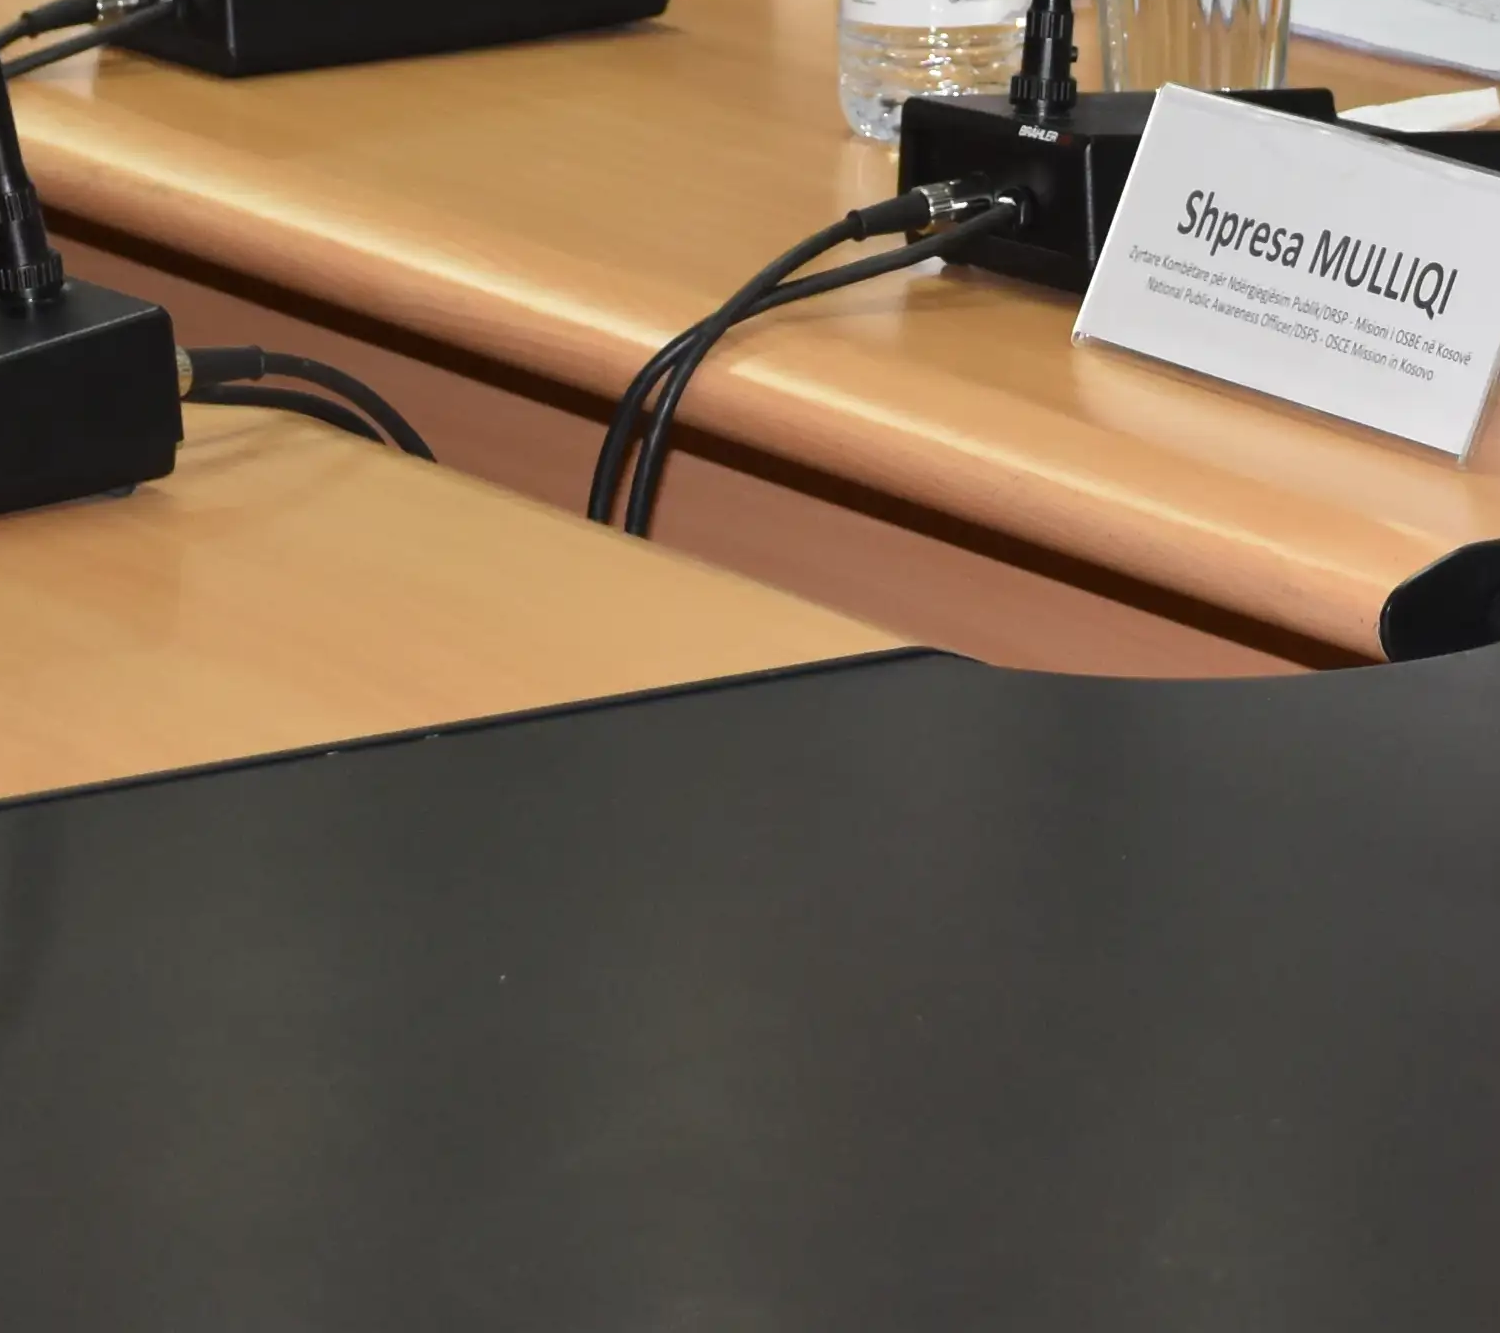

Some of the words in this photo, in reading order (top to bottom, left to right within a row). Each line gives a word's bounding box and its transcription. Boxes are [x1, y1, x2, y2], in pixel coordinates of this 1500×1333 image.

[1128, 244, 1161, 267] Zyrtare
[1161, 254, 1211, 282] Kombëtare
[1353, 316, 1391, 340] Misioni
[1394, 328, 1423, 351] OSBE
[1421, 338, 1437, 355] në
[1436, 343, 1474, 367] Kosovë
[1176, 189, 1304, 268] Shpresa
[1307, 229, 1459, 321] MULLIQI
[1147, 276, 1184, 301] National
[1183, 286, 1211, 310] Public
[1210, 297, 1261, 327] Awareness
[1260, 311, 1321, 345] Officer/DSPS
[1324, 333, 1352, 355] OSCE
[1350, 340, 1388, 366] Mission
[1387, 353, 1399, 370] in
[1398, 358, 1435, 382] Kosovo
